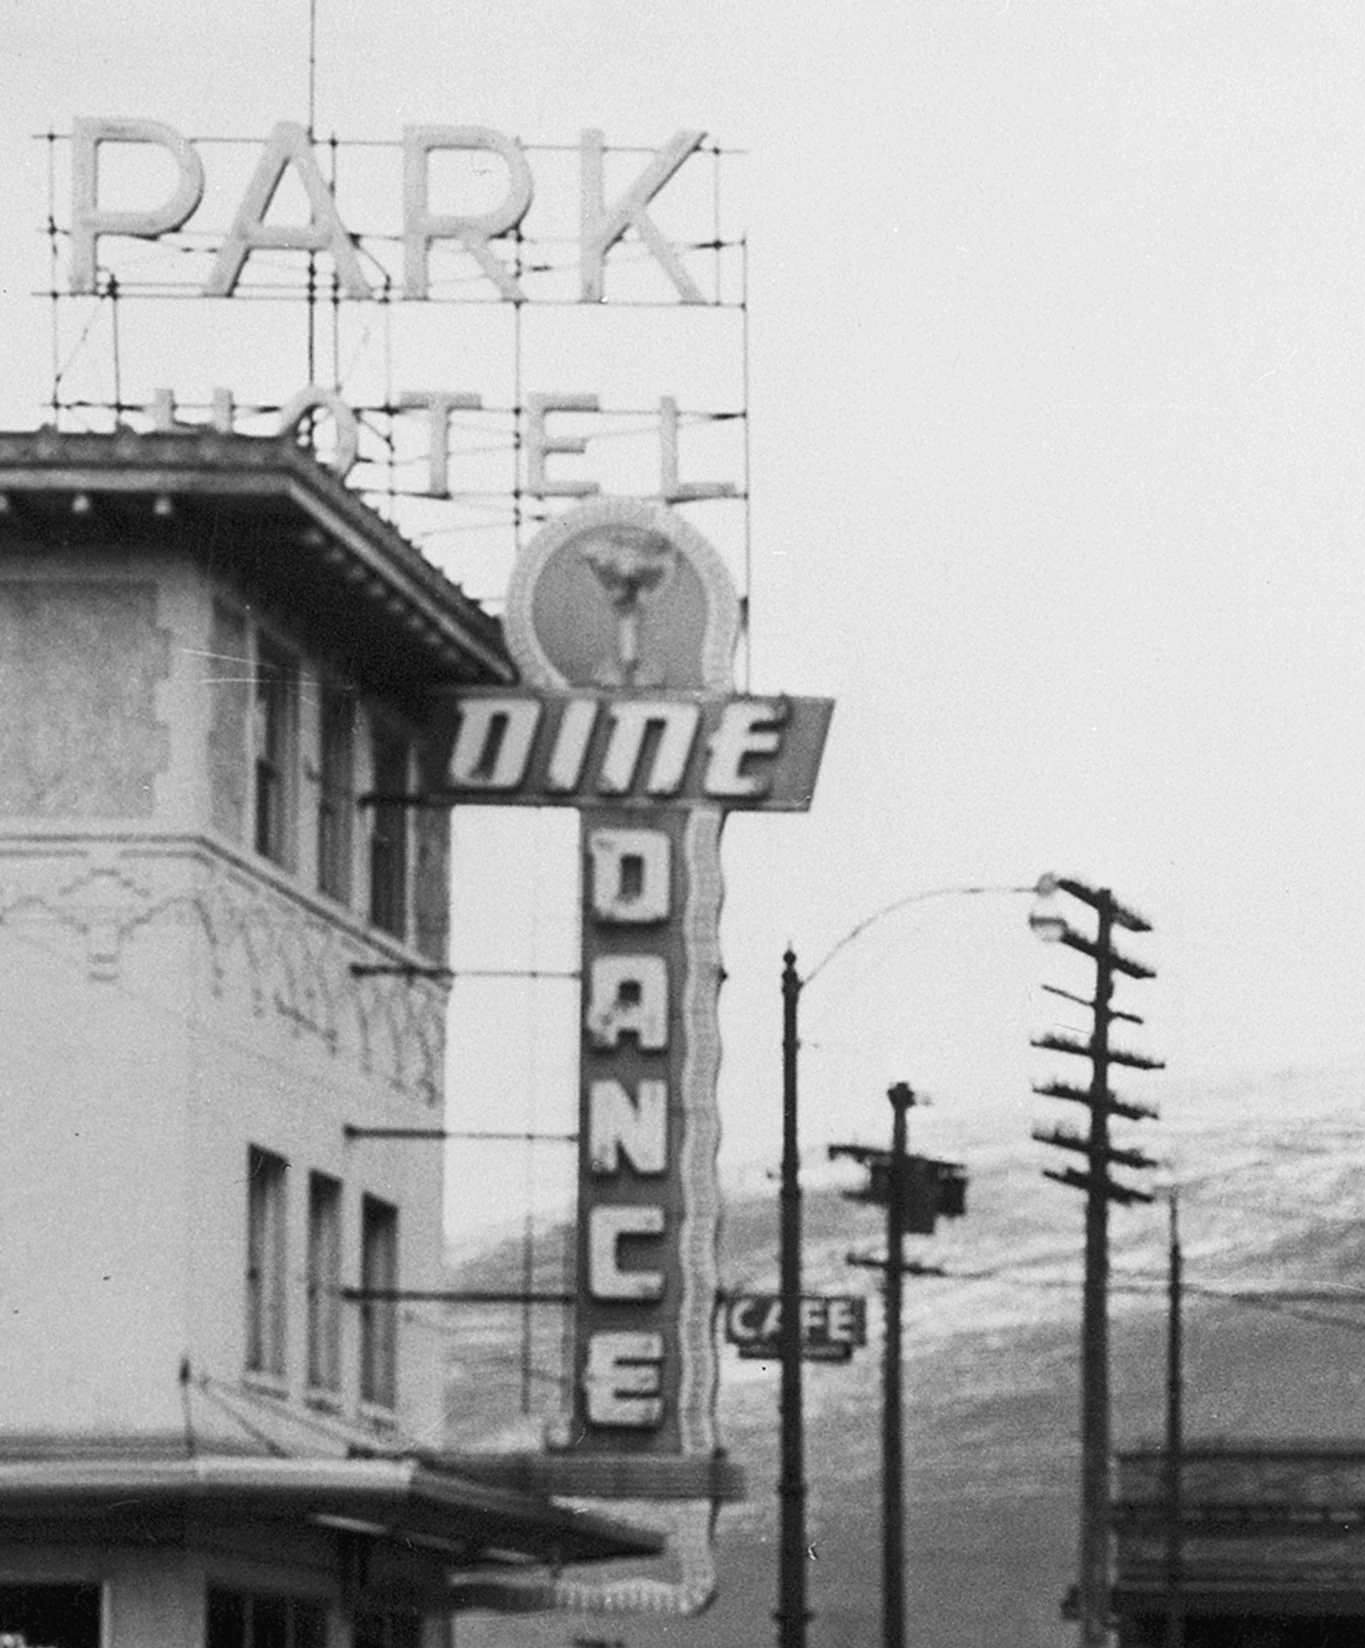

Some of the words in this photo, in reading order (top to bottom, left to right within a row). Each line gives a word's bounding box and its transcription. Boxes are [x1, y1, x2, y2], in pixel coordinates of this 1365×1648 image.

[69, 116, 710, 304] PARK
[448, 696, 781, 797] DINE
[586, 828, 673, 1429] DANCE
